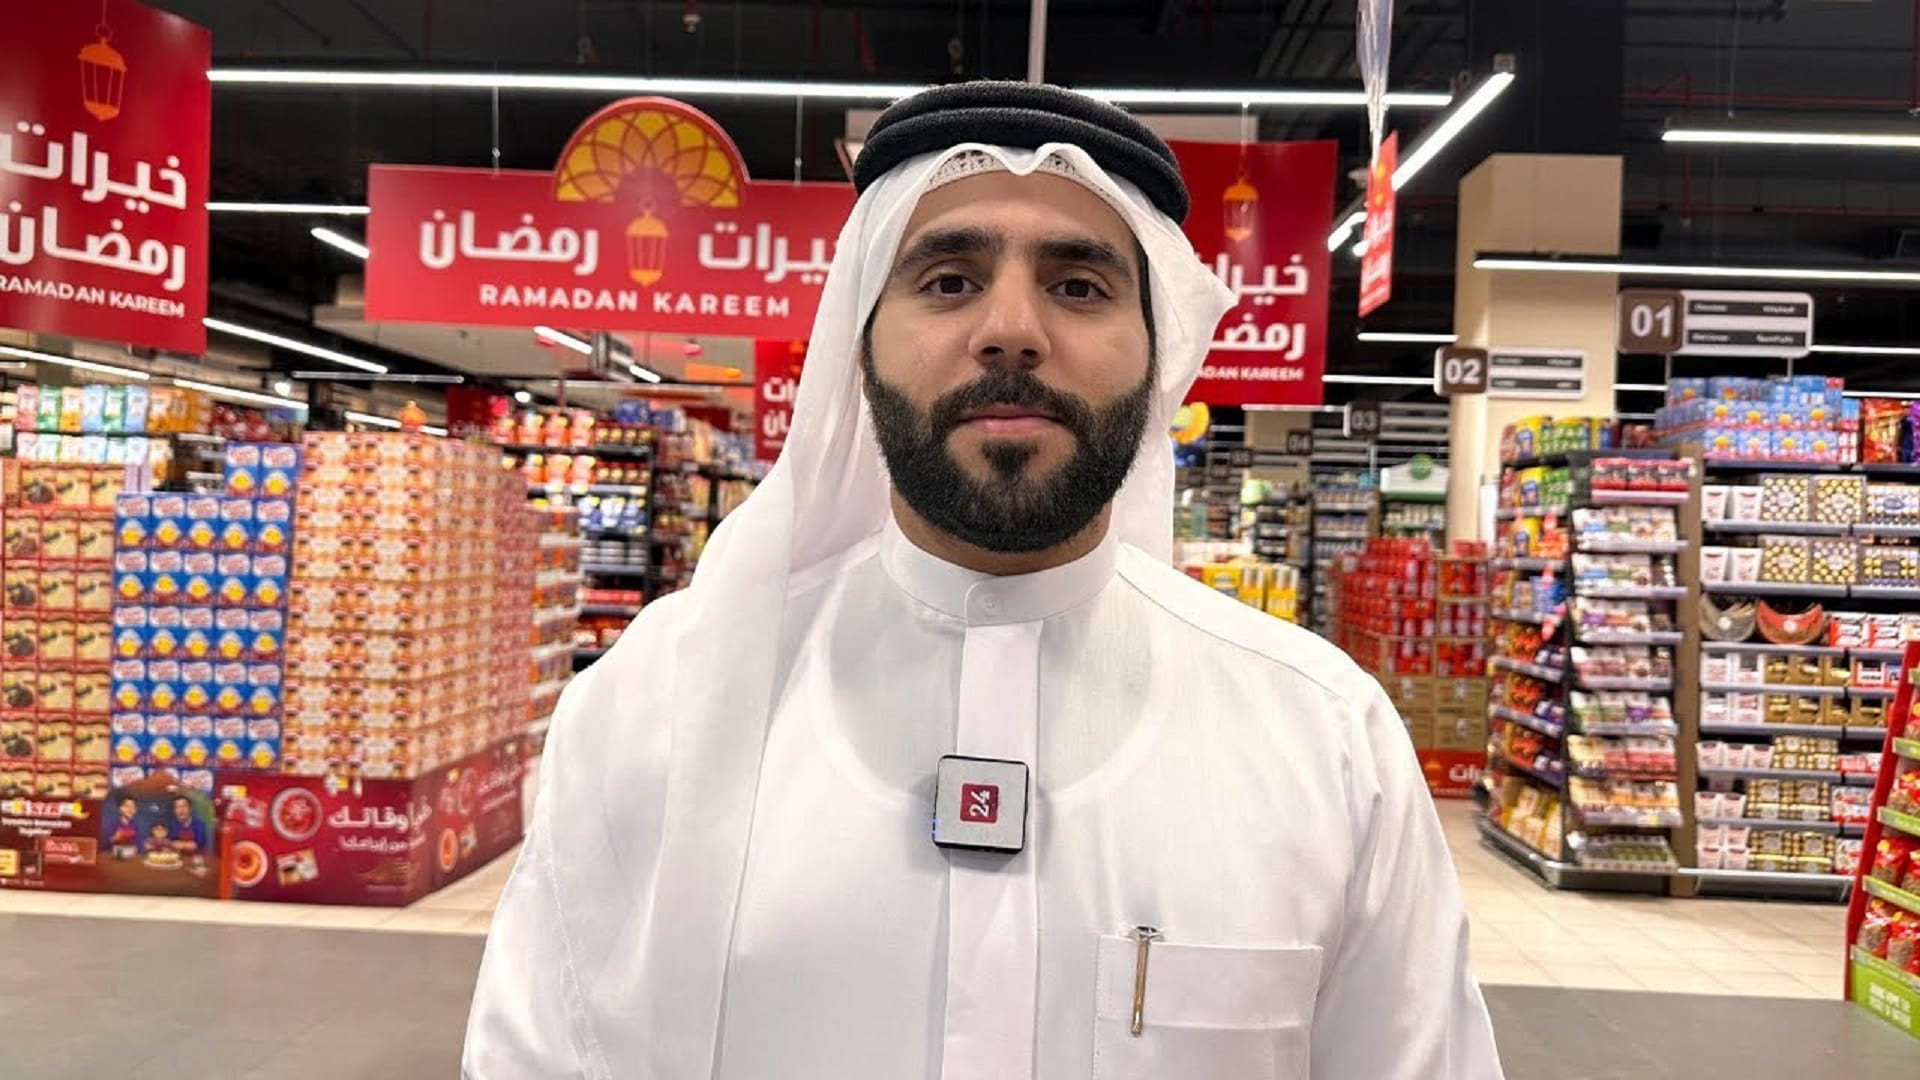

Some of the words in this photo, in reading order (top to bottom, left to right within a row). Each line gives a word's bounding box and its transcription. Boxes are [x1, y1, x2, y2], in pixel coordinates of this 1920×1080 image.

[0, 201, 186, 291] رمضان
[419, 209, 598, 277] رمضان
[698, 221, 836, 285] يرات
[0, 275, 105, 304] RAMADAN
[109, 291, 185, 318] KAREEM
[480, 283, 638, 311] RAMADAN
[653, 292, 790, 318] KAREEM
[1631, 304, 1673, 338] 01
[1241, 366, 1304, 381] KAREEM
[1445, 358, 1481, 385] 02
[969, 790, 990, 818] 24
